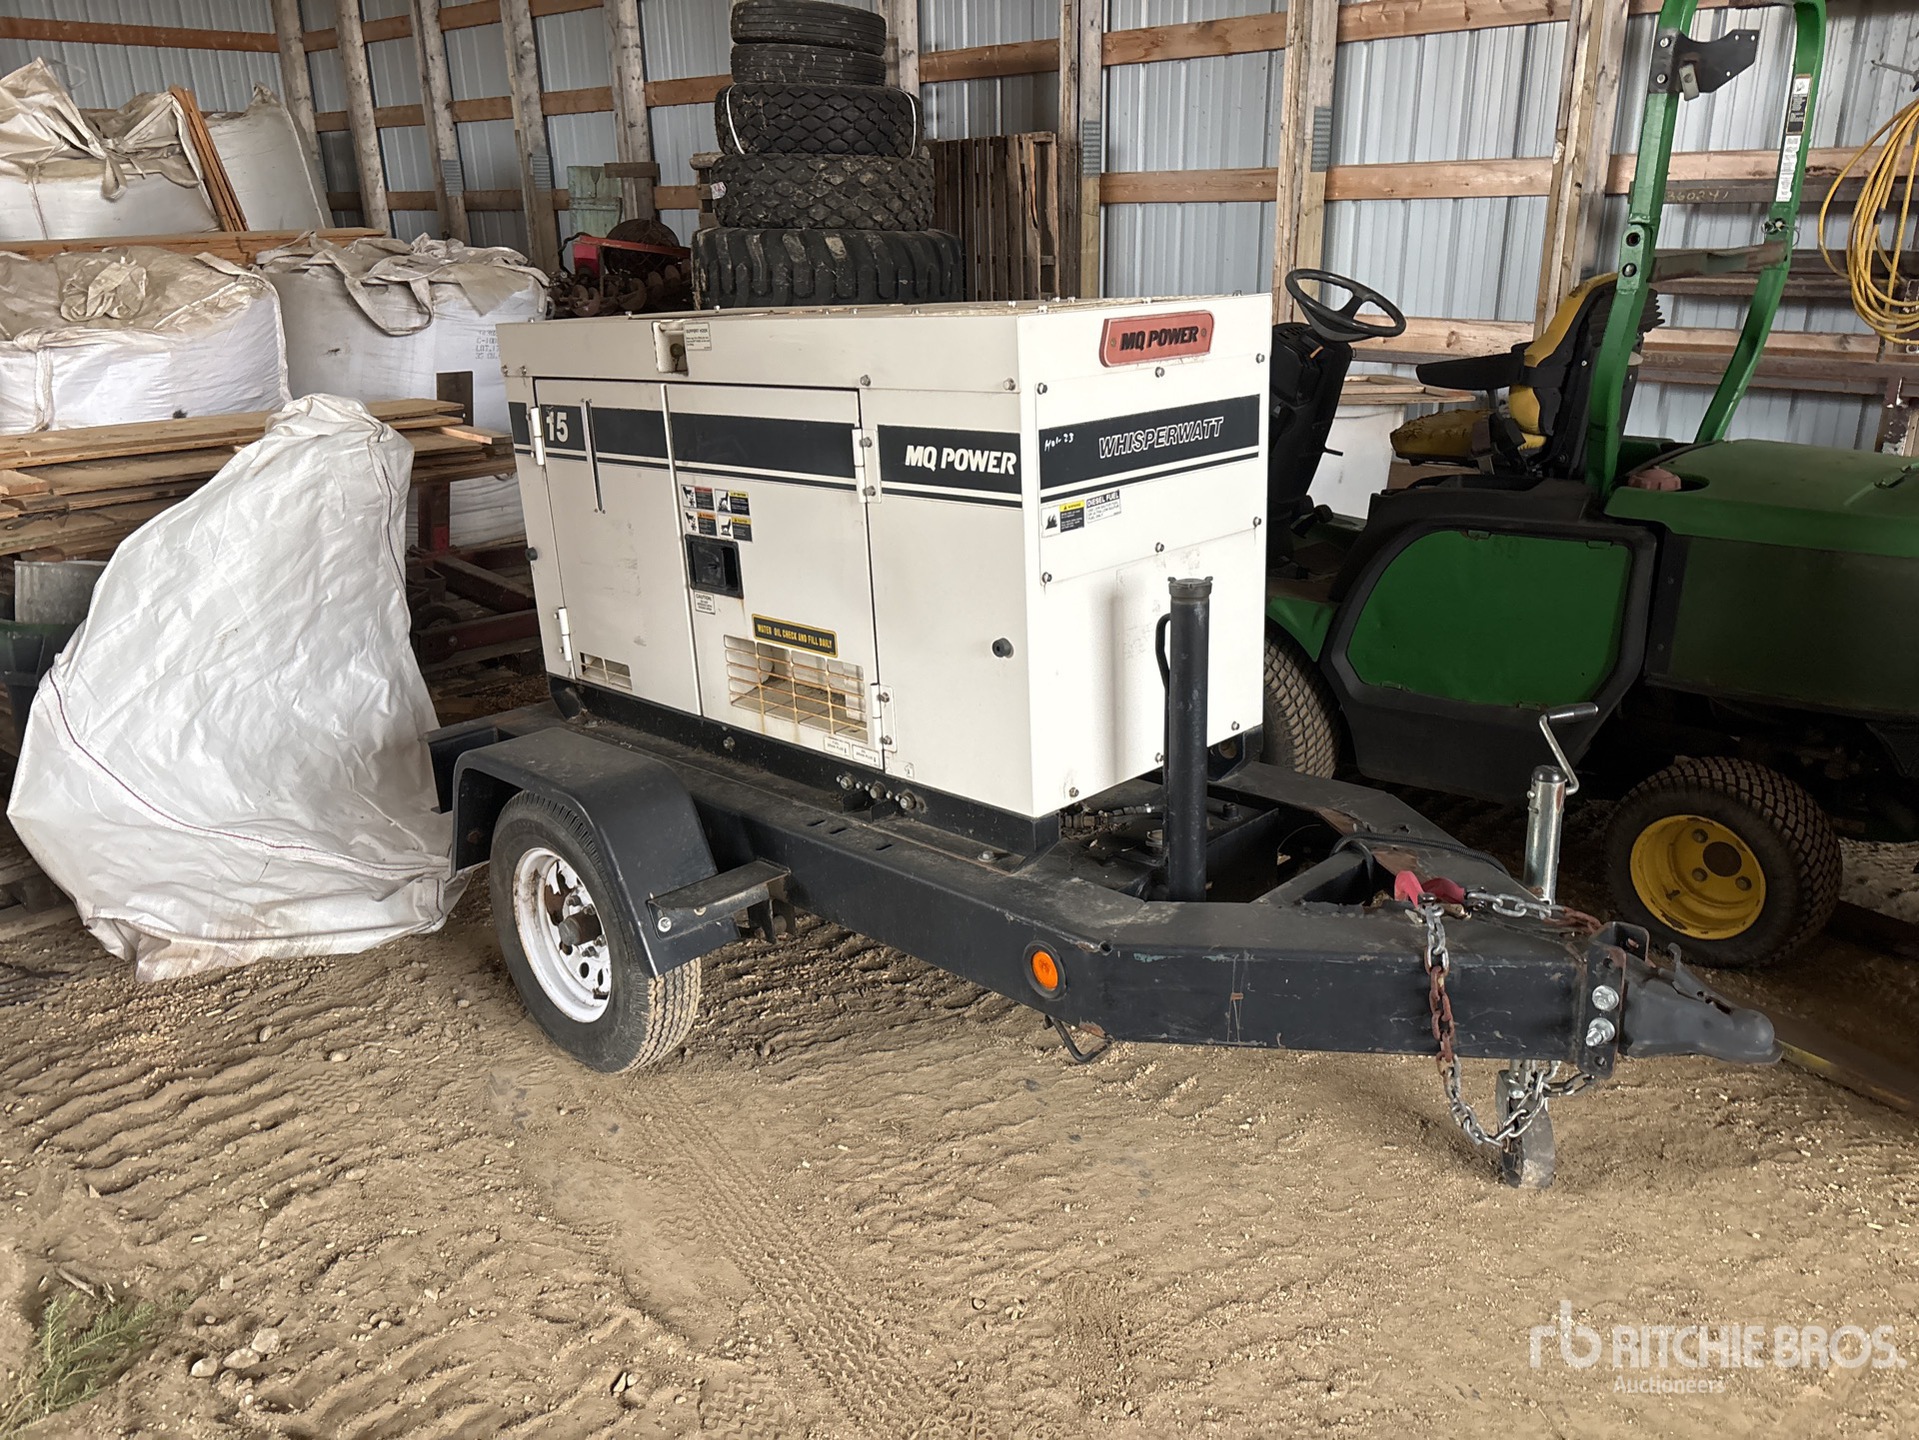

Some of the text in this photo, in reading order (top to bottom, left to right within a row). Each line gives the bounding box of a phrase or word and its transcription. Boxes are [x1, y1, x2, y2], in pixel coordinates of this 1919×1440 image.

[1119, 326, 1199, 352] MQ POWER
[546, 411, 569, 442] 15
[1098, 416, 1225, 459] WHISPERWATT
[904, 444, 1017, 475] MQ POWER
[1086, 495, 1105, 507] DIESEL
[1106, 491, 1120, 502] FUEL
[757, 623, 832, 649] WATER OIL CHECK AND FILL DAILY
